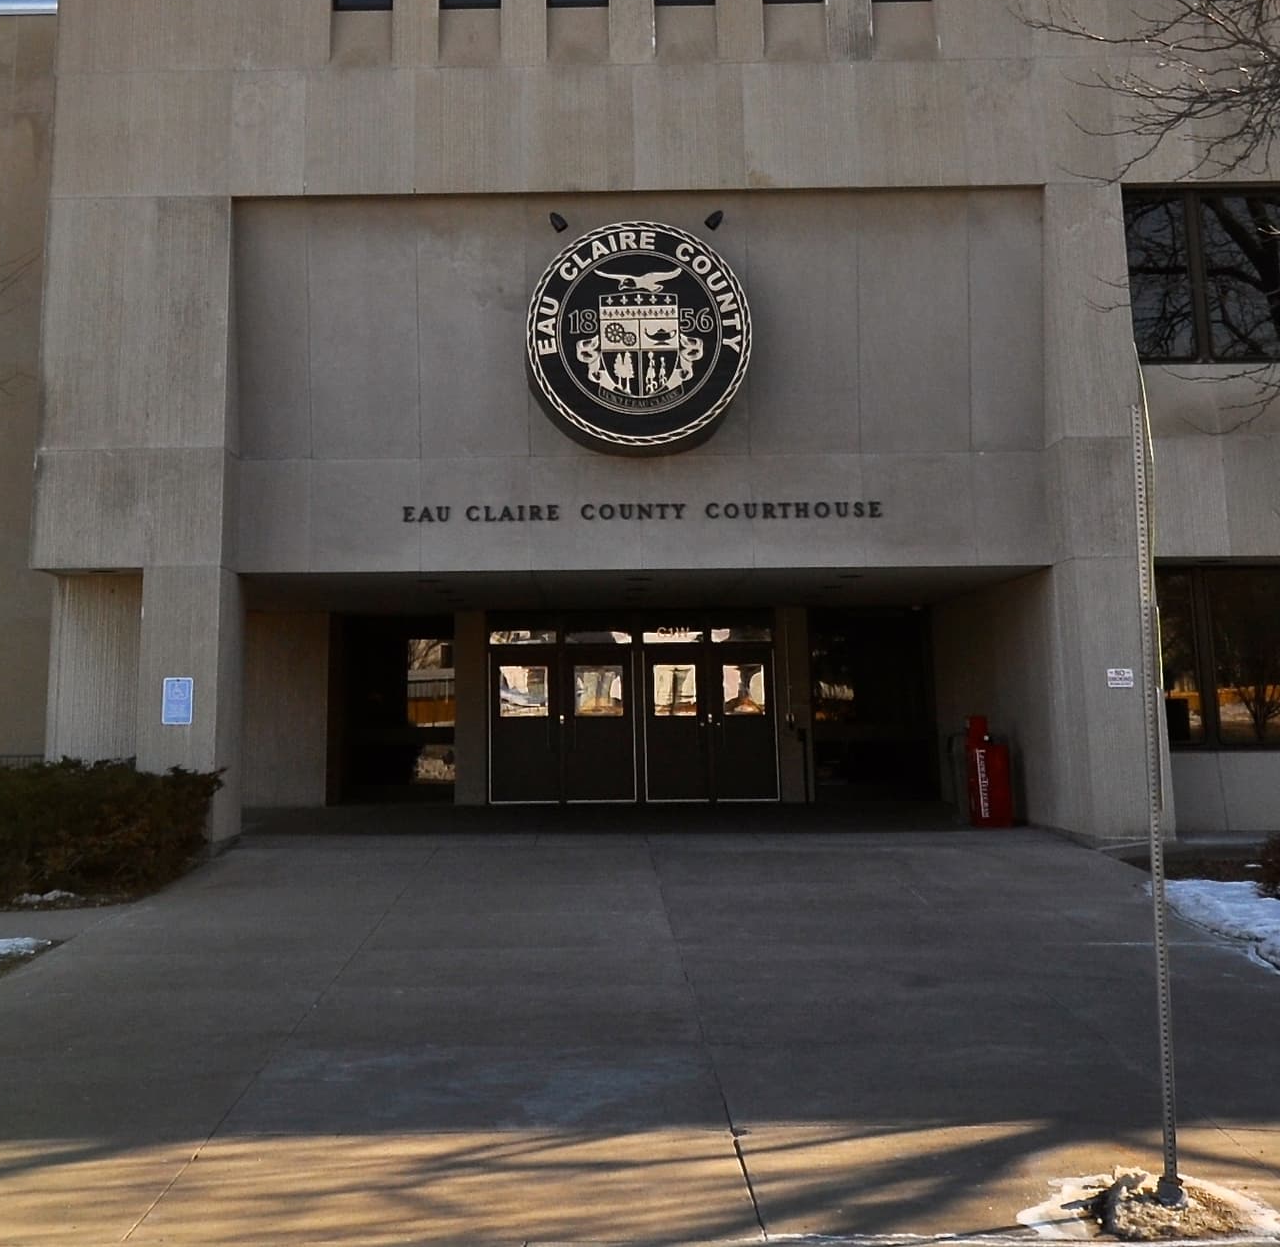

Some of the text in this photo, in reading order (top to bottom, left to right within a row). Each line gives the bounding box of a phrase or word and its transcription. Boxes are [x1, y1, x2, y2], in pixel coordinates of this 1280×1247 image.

[537, 232, 742, 356] EAU CLAIRE COUNTY
[568, 308, 714, 334] 18 56
[402, 501, 883, 523] EAU CLAIRE COUNTY COURTHOUSE
